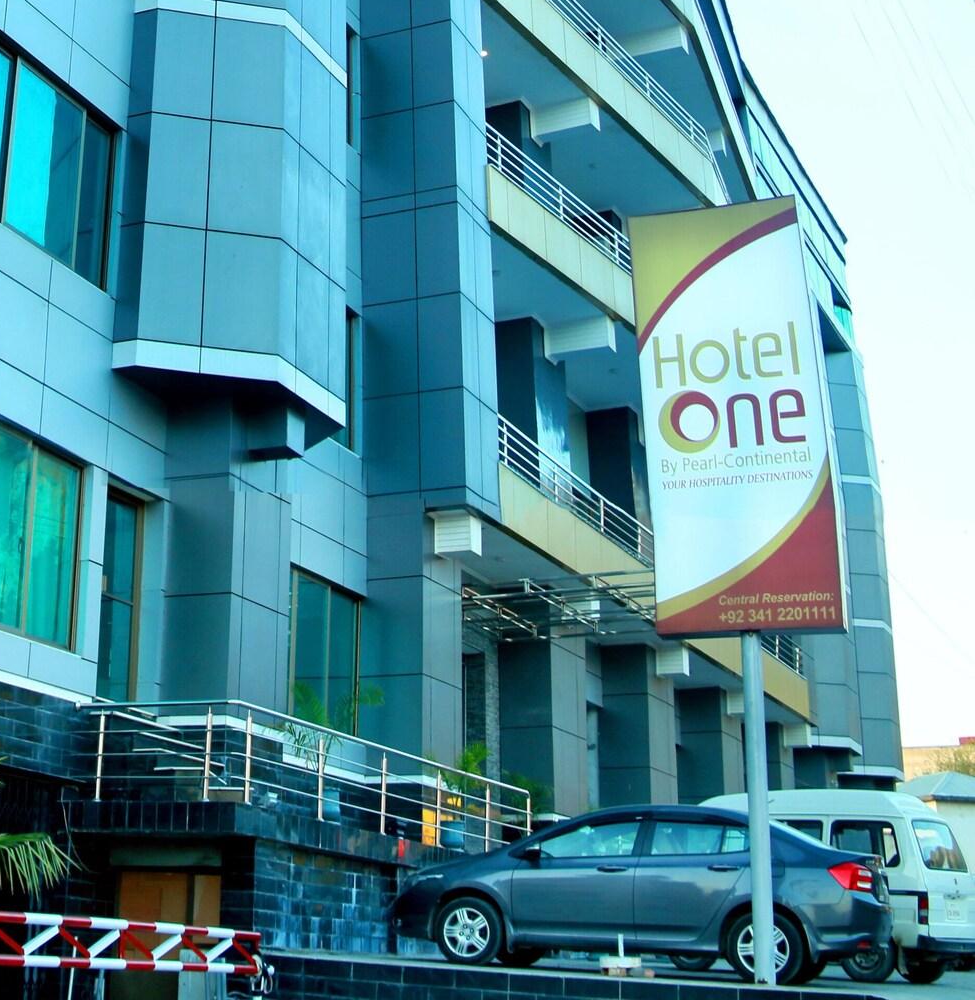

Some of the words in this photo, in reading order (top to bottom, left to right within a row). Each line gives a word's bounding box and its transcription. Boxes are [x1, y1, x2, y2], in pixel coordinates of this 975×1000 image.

[652, 321, 800, 388] Hotel
[658, 389, 806, 454] One
[661, 458, 678, 476] By
[682, 446, 812, 472] Pearl-Continental
[662, 479, 687, 490] YOUR
[689, 475, 745, 488] HOSPITALITY
[747, 470, 813, 484] DESTINATIONS
[719, 593, 759, 605] Central
[762, 591, 834, 603] Reservation:
[719, 609, 744, 623] +92
[748, 608, 771, 622] 341
[777, 606, 836, 621] 2201111
